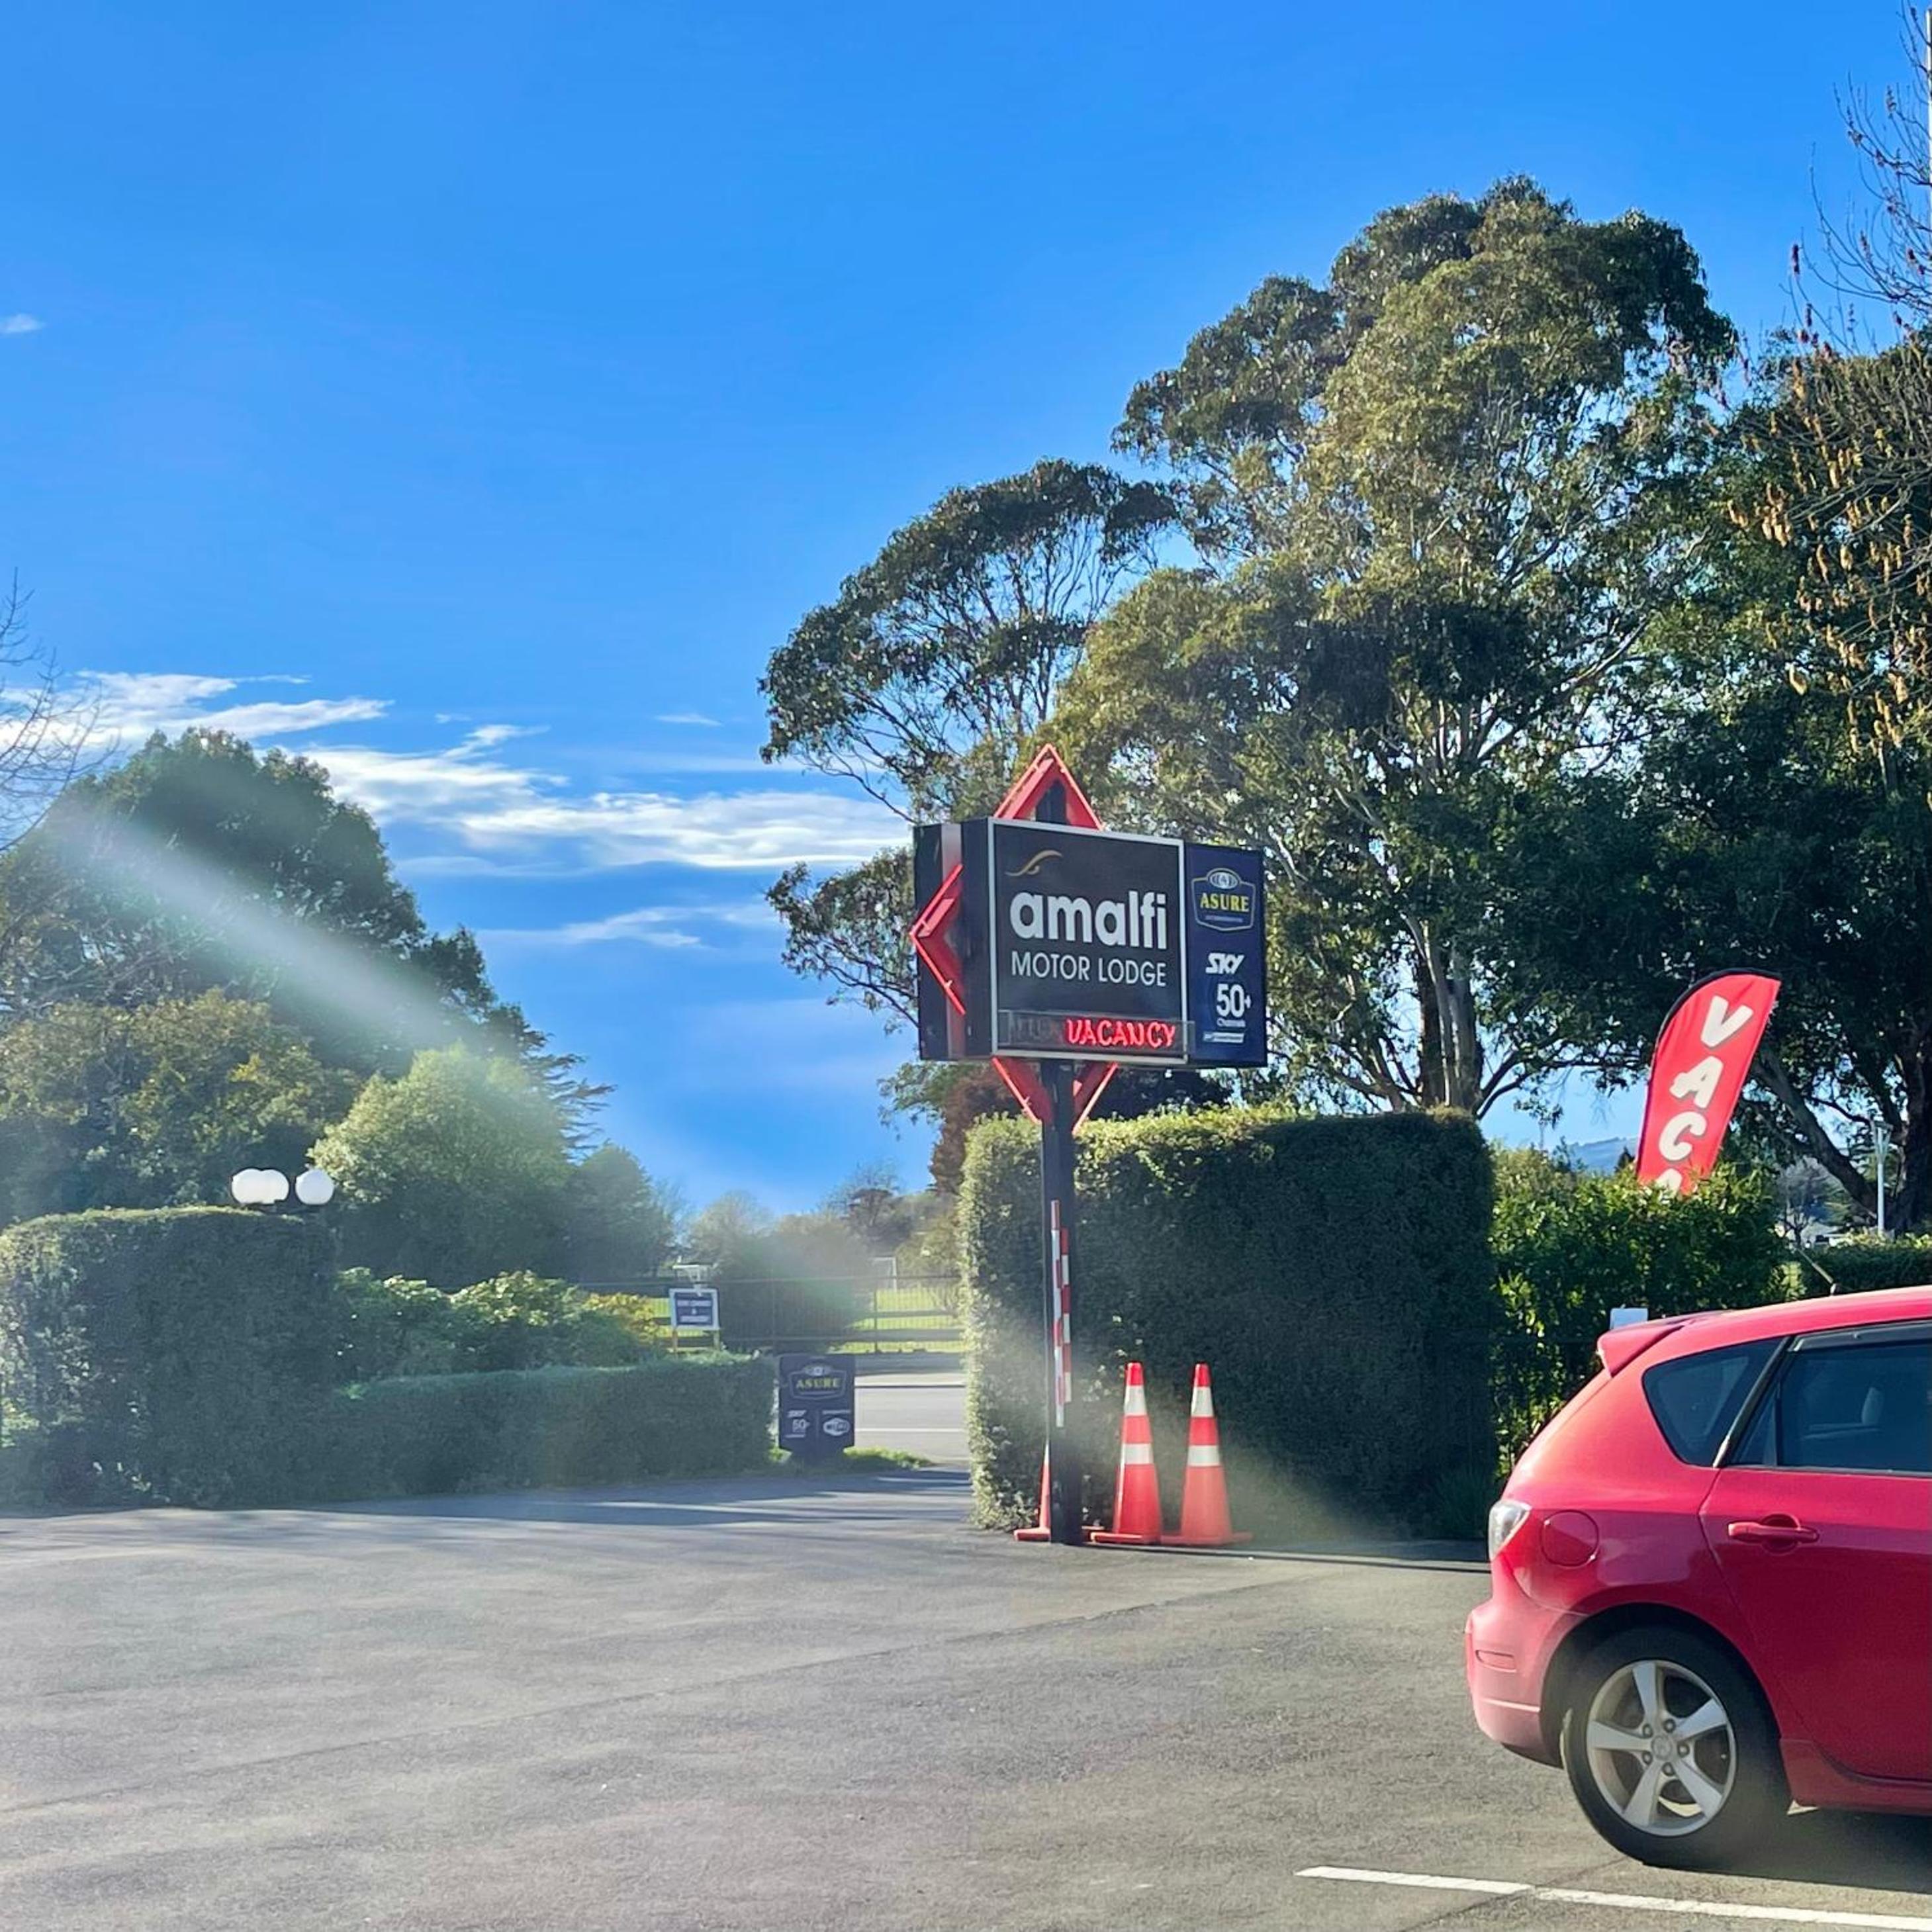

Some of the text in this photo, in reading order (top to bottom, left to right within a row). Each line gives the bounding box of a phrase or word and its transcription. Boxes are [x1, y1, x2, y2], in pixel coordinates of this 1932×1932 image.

[1200, 892, 1250, 913] ASURE
[1010, 891, 1167, 949] amalfi
[1011, 951, 1166, 986] MOTOR LODGE
[1205, 952, 1245, 974] SKY
[1066, 1019, 1175, 1048] VACANCY
